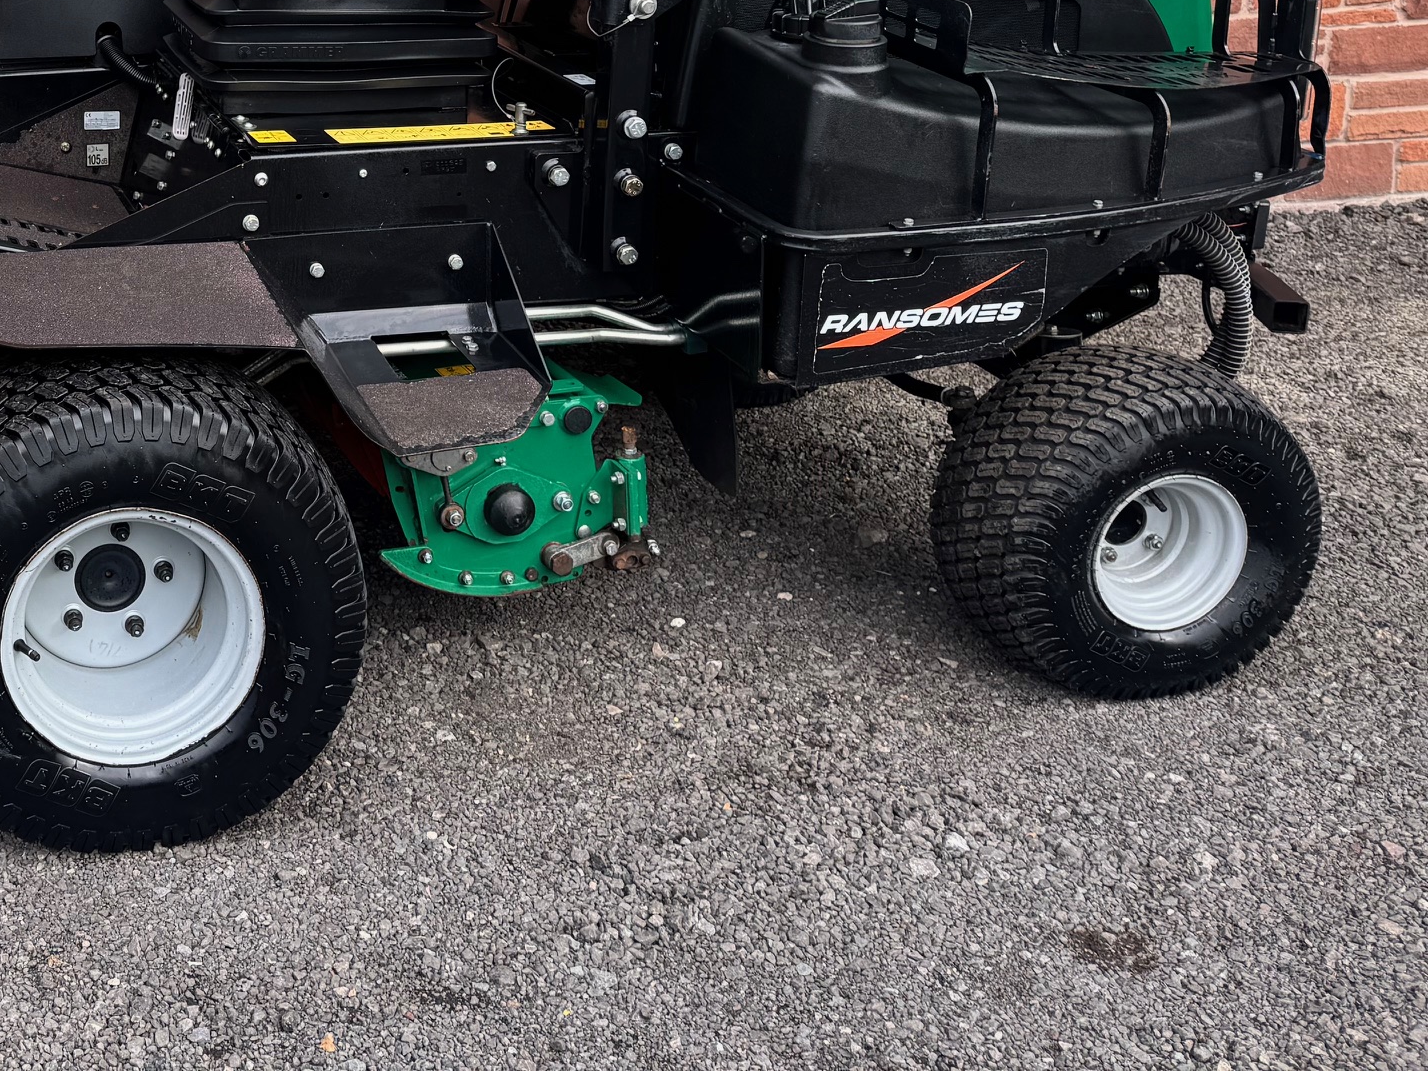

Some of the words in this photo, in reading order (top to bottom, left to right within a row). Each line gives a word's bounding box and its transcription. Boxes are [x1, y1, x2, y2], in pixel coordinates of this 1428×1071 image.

[820, 301, 1025, 335] RANSOMES
[153, 466, 252, 517] BKT
[247, 641, 311, 753] LG-306
[20, 764, 117, 813] BKT
